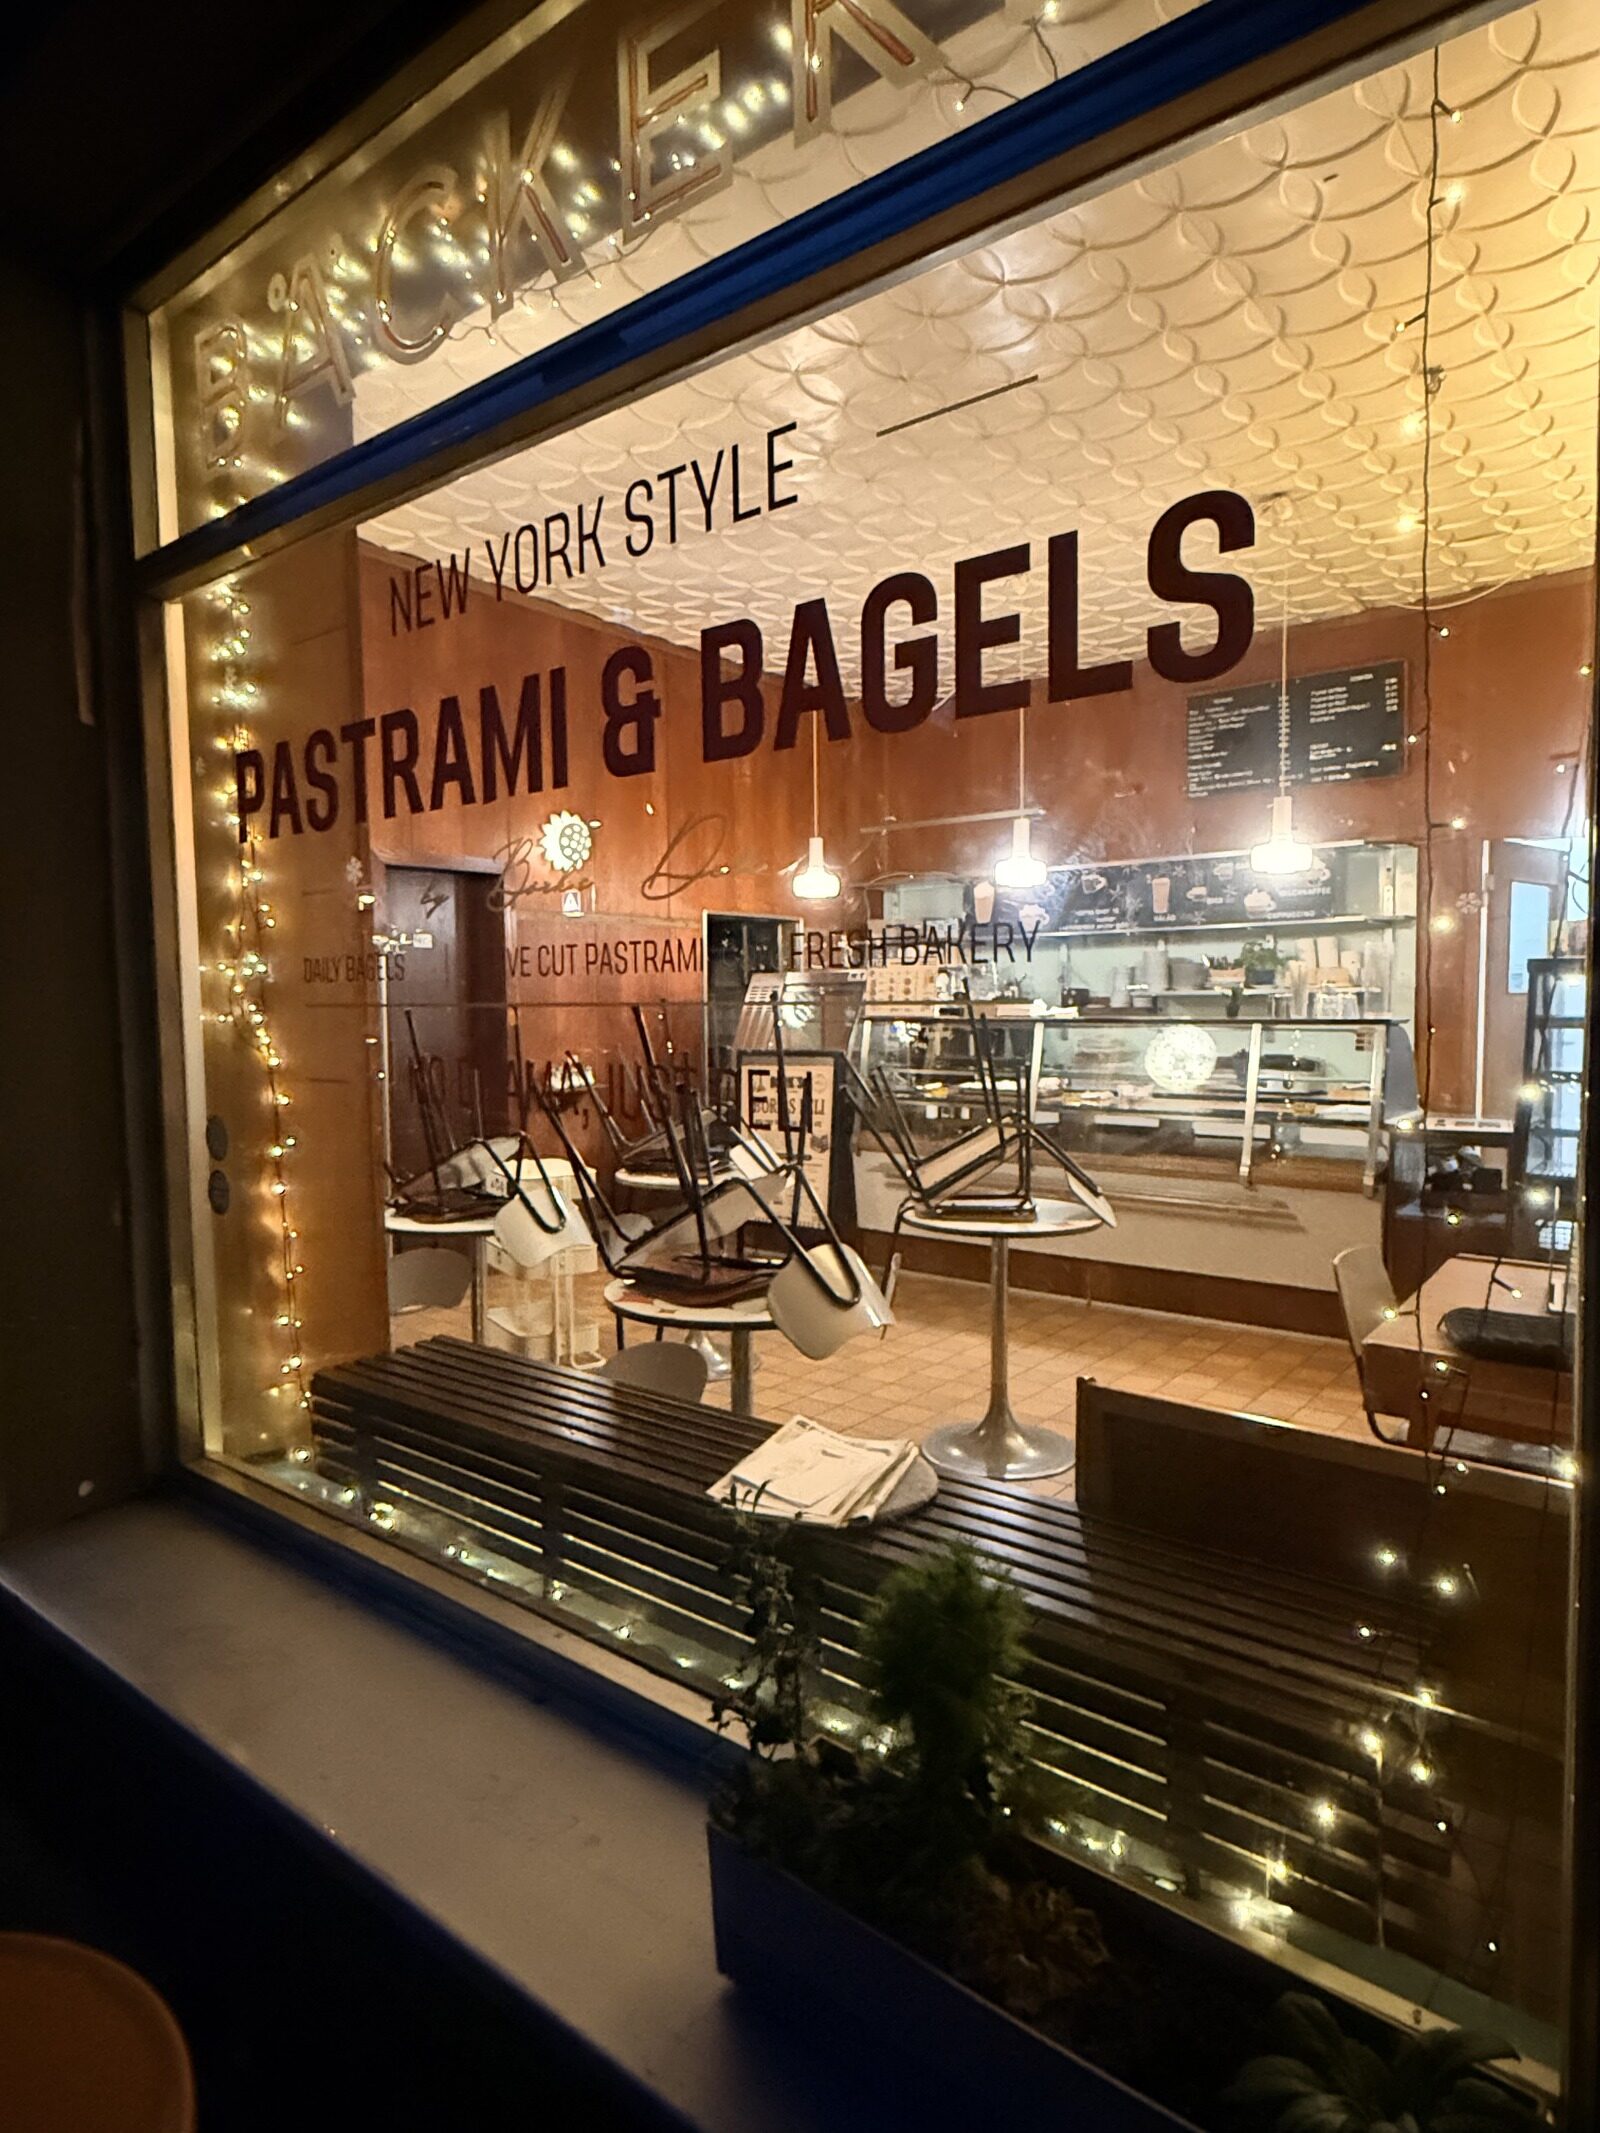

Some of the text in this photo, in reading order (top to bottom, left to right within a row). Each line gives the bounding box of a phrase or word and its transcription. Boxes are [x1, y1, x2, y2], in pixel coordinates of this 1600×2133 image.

[388, 422, 798, 637] NEW YORK STYLE
[235, 666, 569, 844] PASTRAMI
[602, 645, 662, 778] &
[701, 489, 1255, 763] BAGELS
[303, 950, 406, 983] DAILY BAGELS
[538, 943, 579, 977] CUT
[585, 938, 705, 975] PASTRAMI
[791, 919, 1041, 971] FRESH BAKERY
